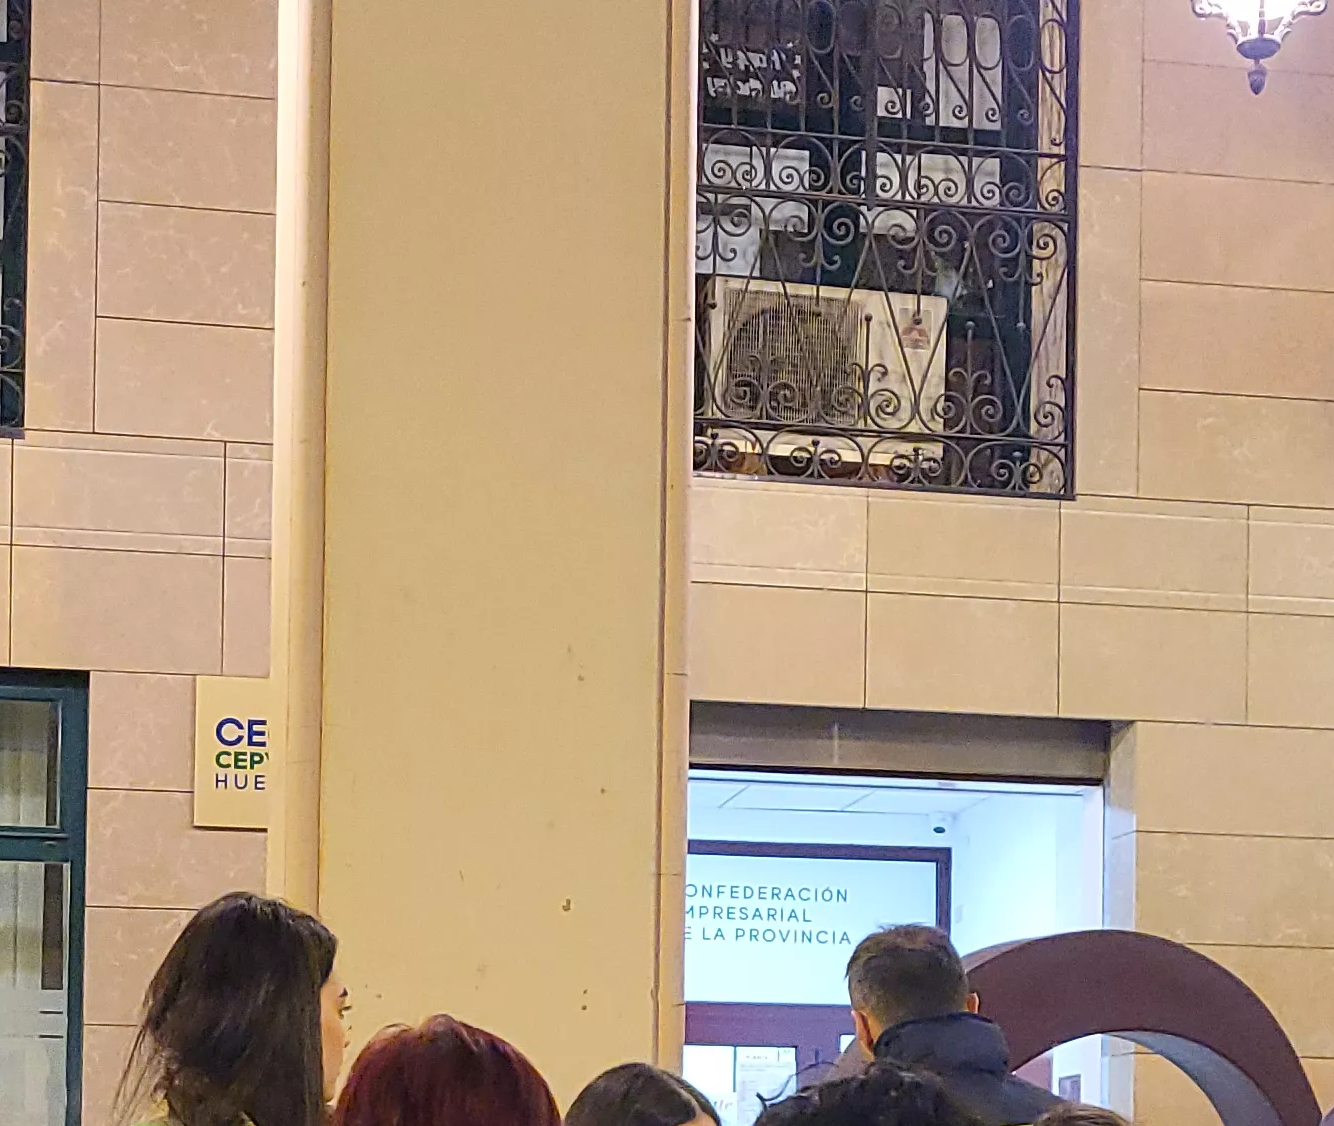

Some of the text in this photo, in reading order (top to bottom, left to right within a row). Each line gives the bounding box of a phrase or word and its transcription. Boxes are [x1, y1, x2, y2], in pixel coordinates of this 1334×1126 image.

[215, 717, 269, 747] CE
[215, 750, 269, 770] CEP
[702, 927, 726, 941] LA
[735, 927, 852, 945] PROVINCIA
